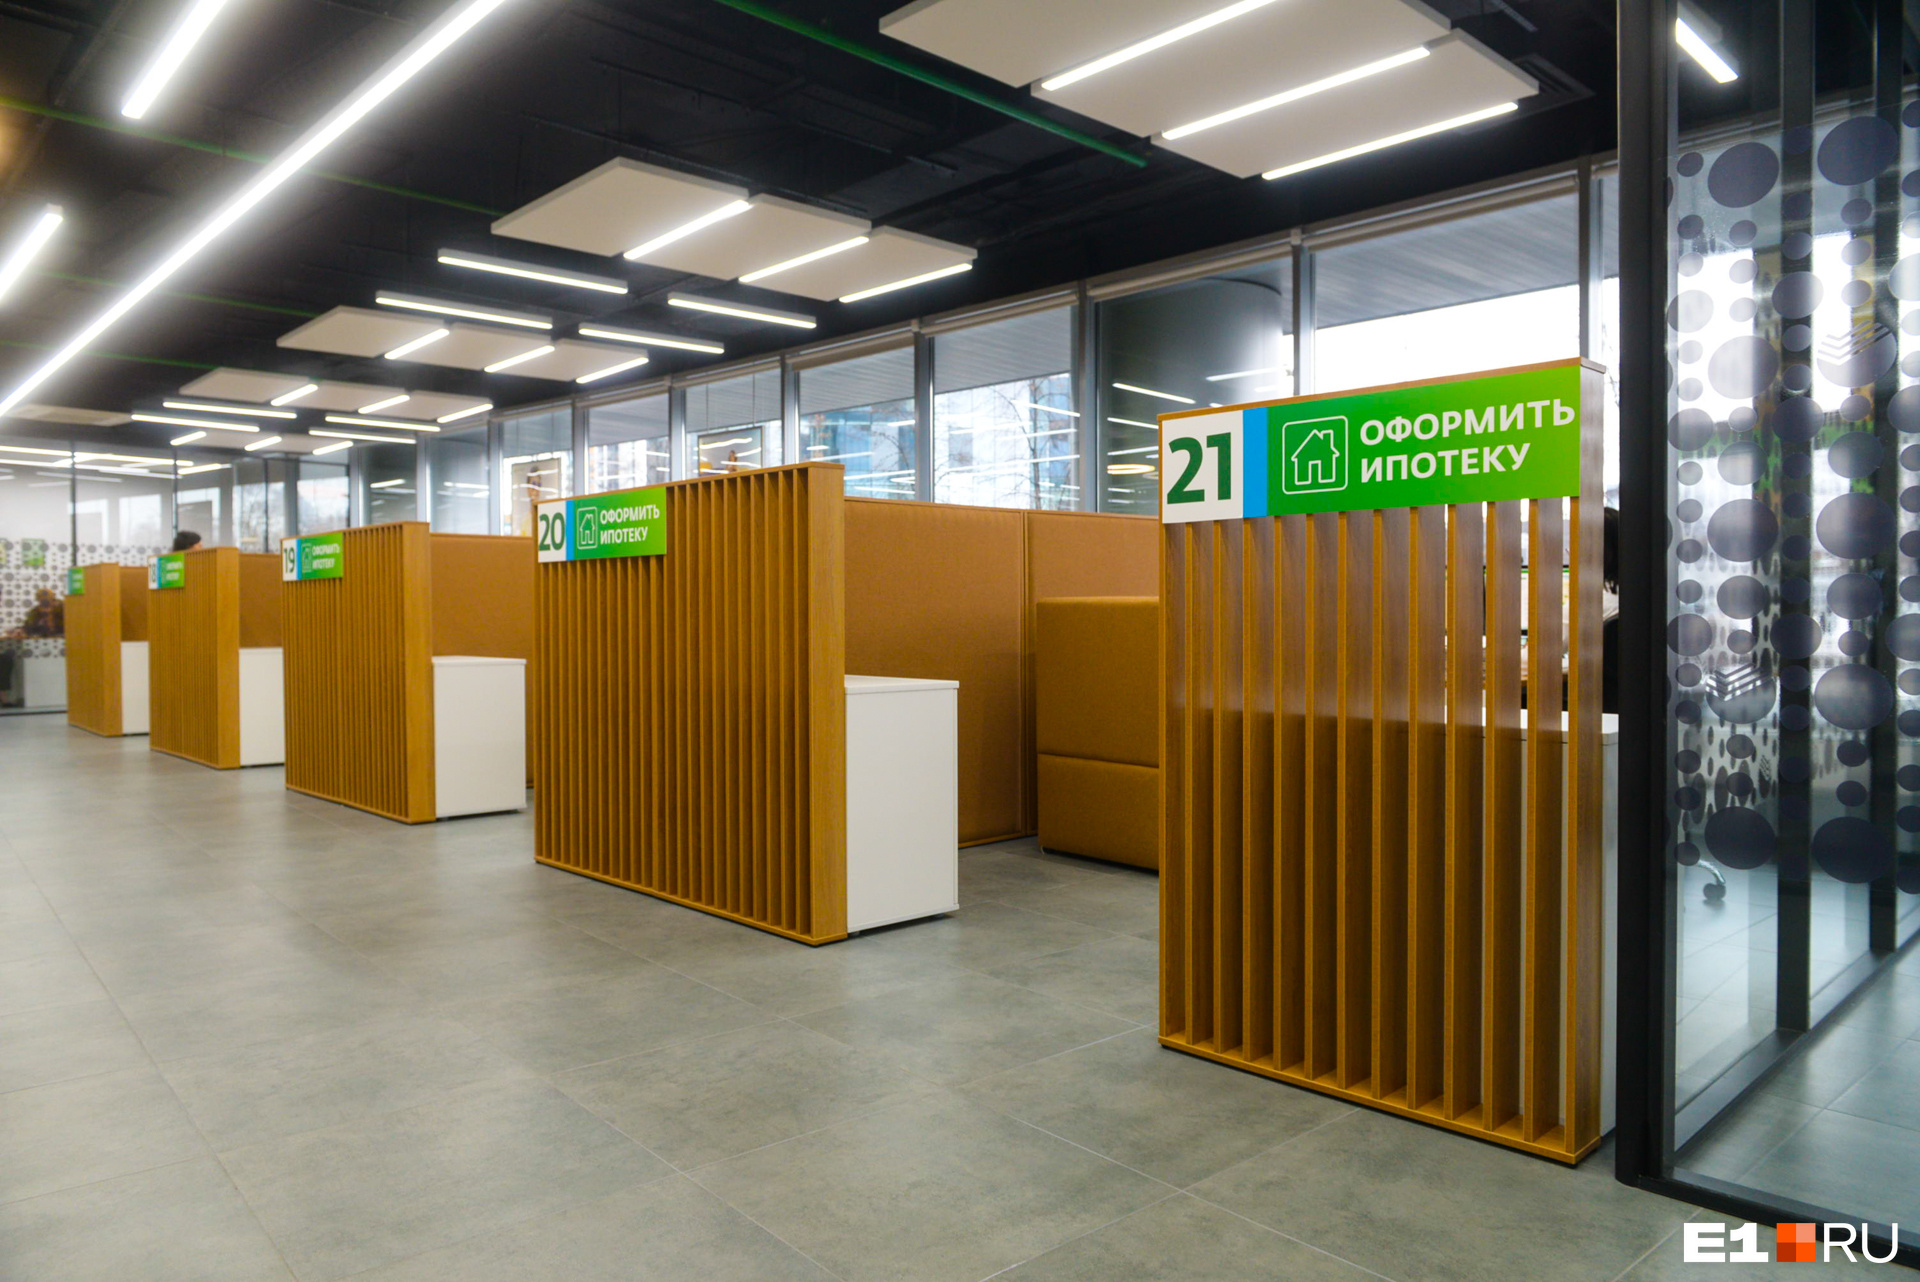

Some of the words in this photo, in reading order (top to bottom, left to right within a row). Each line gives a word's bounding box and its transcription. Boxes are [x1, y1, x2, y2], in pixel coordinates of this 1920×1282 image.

[1359, 399, 1576, 445] ОФОРМИТЬ
[1166, 431, 1231, 505] 21
[1360, 443, 1531, 483] ИПОТЕКУ
[538, 512, 565, 552] 20
[600, 504, 660, 525] ОФОРМИТЬ
[600, 526, 648, 545] ИПОТЕКУ
[283, 547, 295, 574] 19
